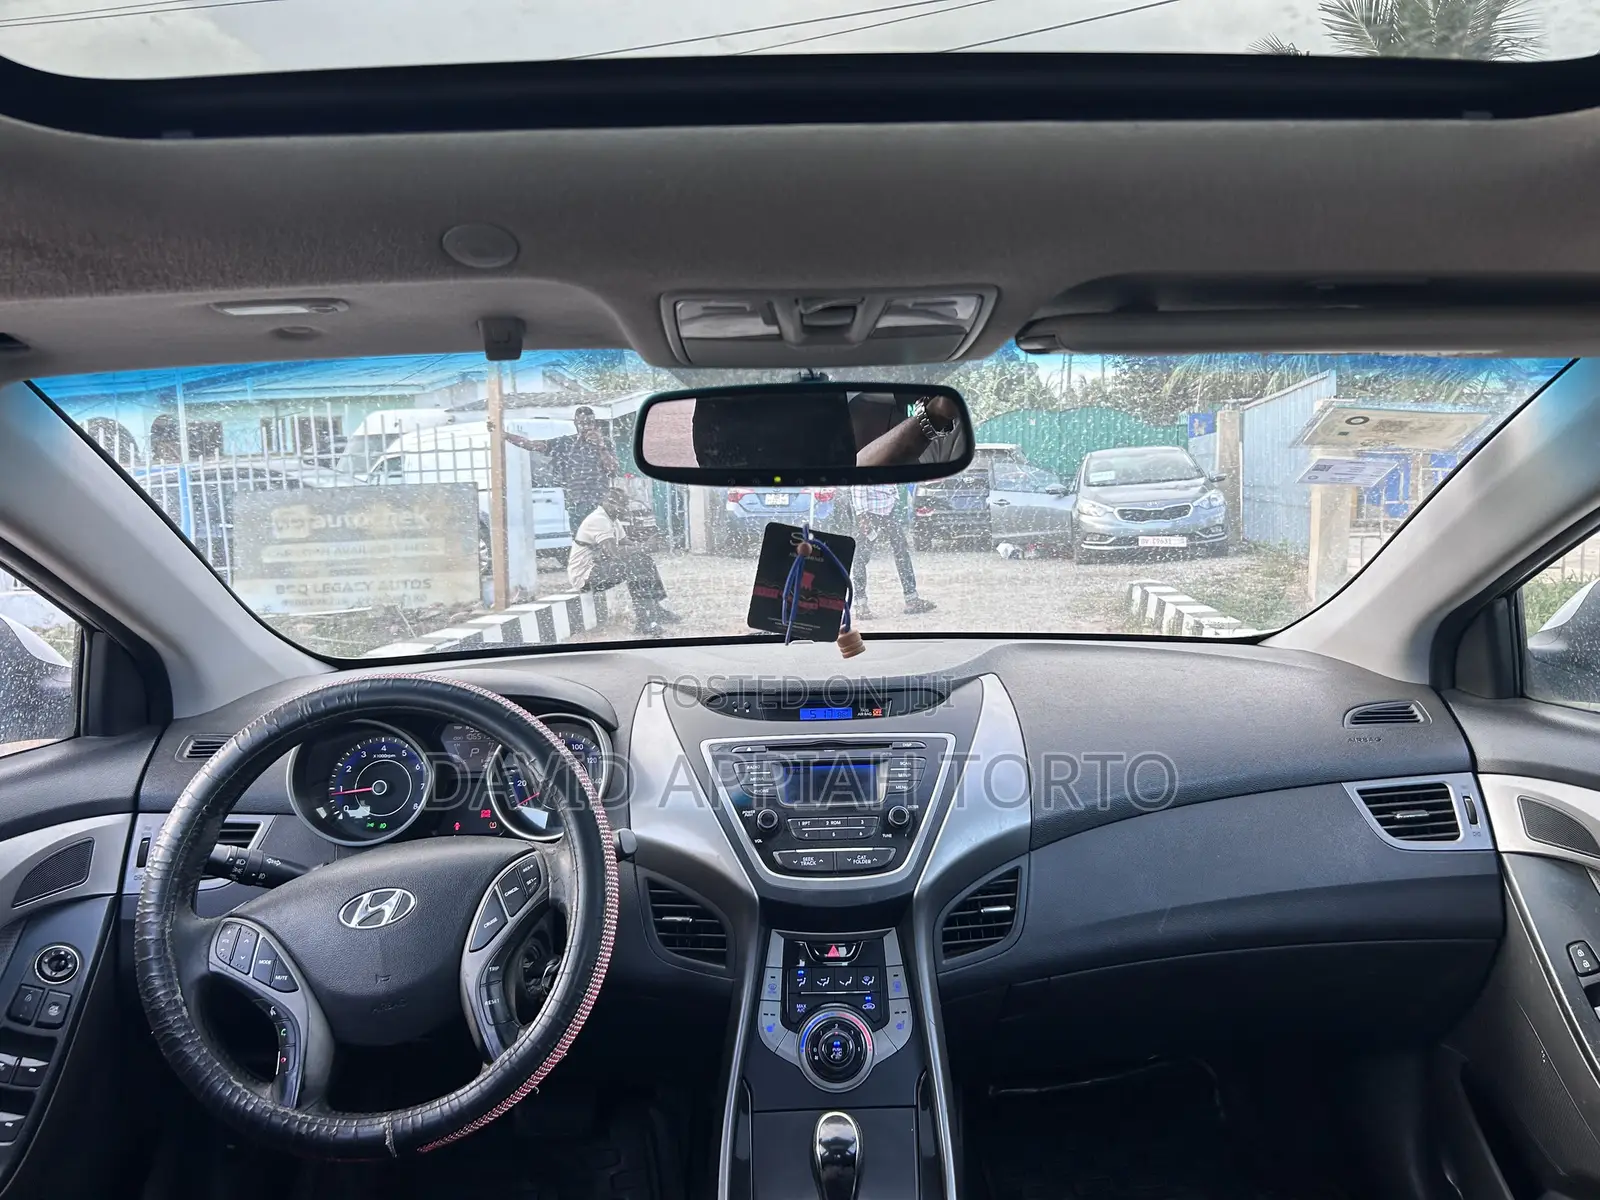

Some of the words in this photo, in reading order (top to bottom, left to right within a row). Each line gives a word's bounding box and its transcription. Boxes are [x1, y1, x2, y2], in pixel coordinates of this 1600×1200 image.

[380, 744, 387, 752] 4
[571, 743, 584, 751] 100
[360, 750, 367, 758] 3
[345, 765, 352, 773] 2
[415, 763, 421, 771] 6
[420, 782, 425, 790] 7
[517, 779, 527, 787] 20
